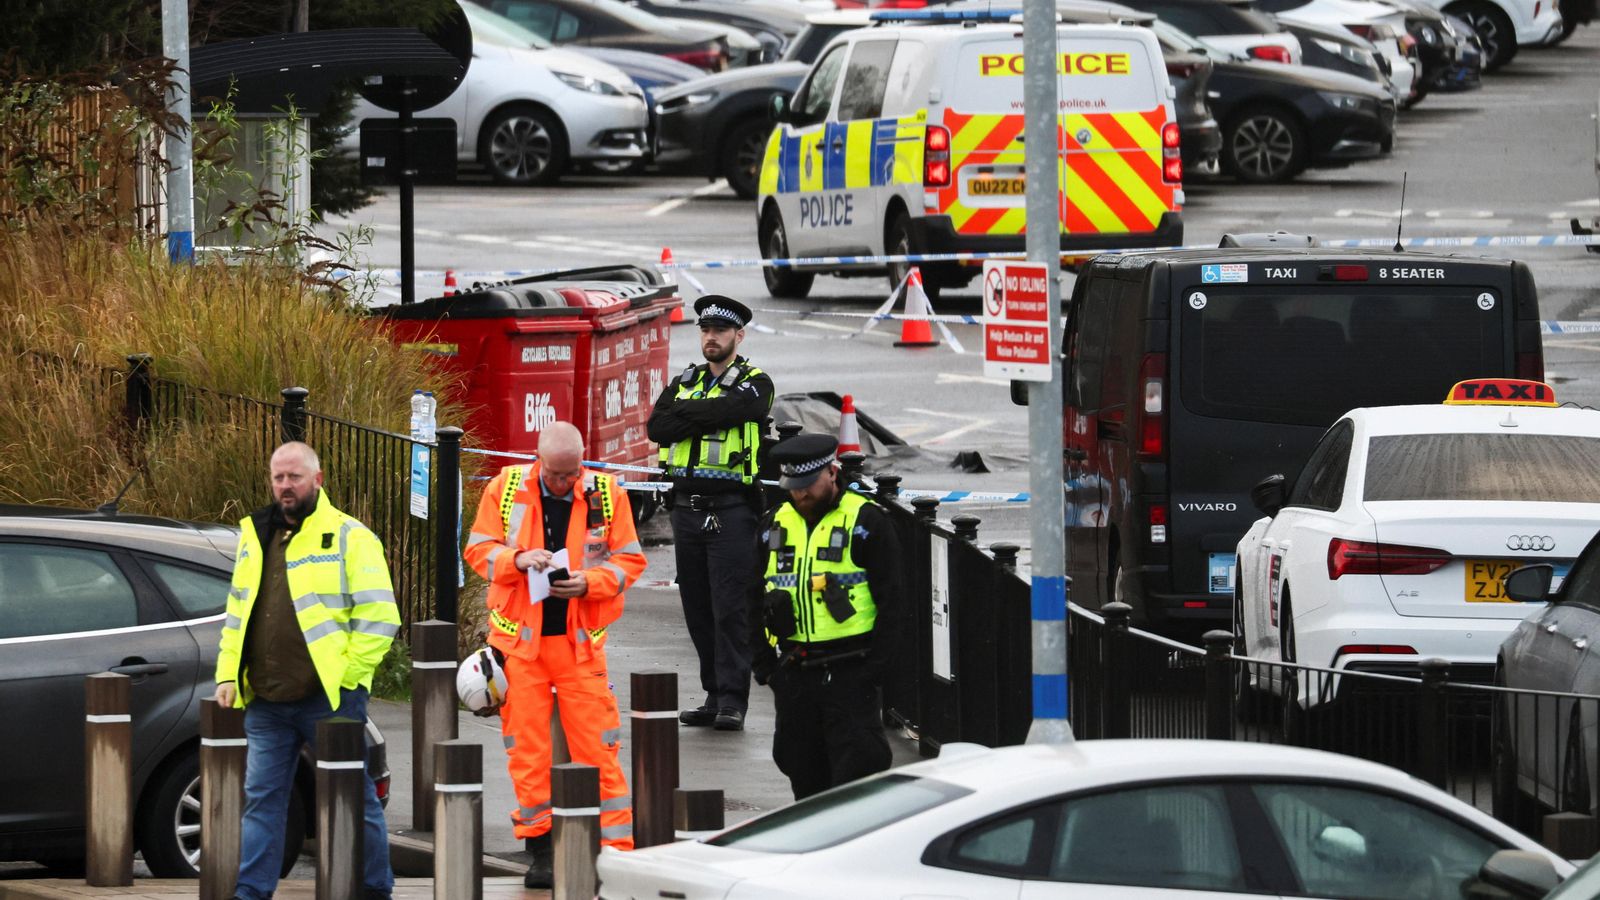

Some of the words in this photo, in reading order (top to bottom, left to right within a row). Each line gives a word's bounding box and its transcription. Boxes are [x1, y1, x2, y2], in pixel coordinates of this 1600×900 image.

[981, 53, 1129, 76] POICE
[973, 179, 1009, 194] OU22
[800, 194, 853, 228] POLICE
[1264, 267, 1297, 278] TAXI
[1379, 268, 1388, 279] 8
[1392, 268, 1445, 279] SEATER
[1006, 276, 1018, 292] NO
[1019, 277, 1046, 294] IDLING
[1461, 383, 1545, 400] TAXI
[1178, 503, 1238, 512] VIVARO
[1472, 563, 1516, 580] FV2
[1474, 581, 1506, 598] ZJ
